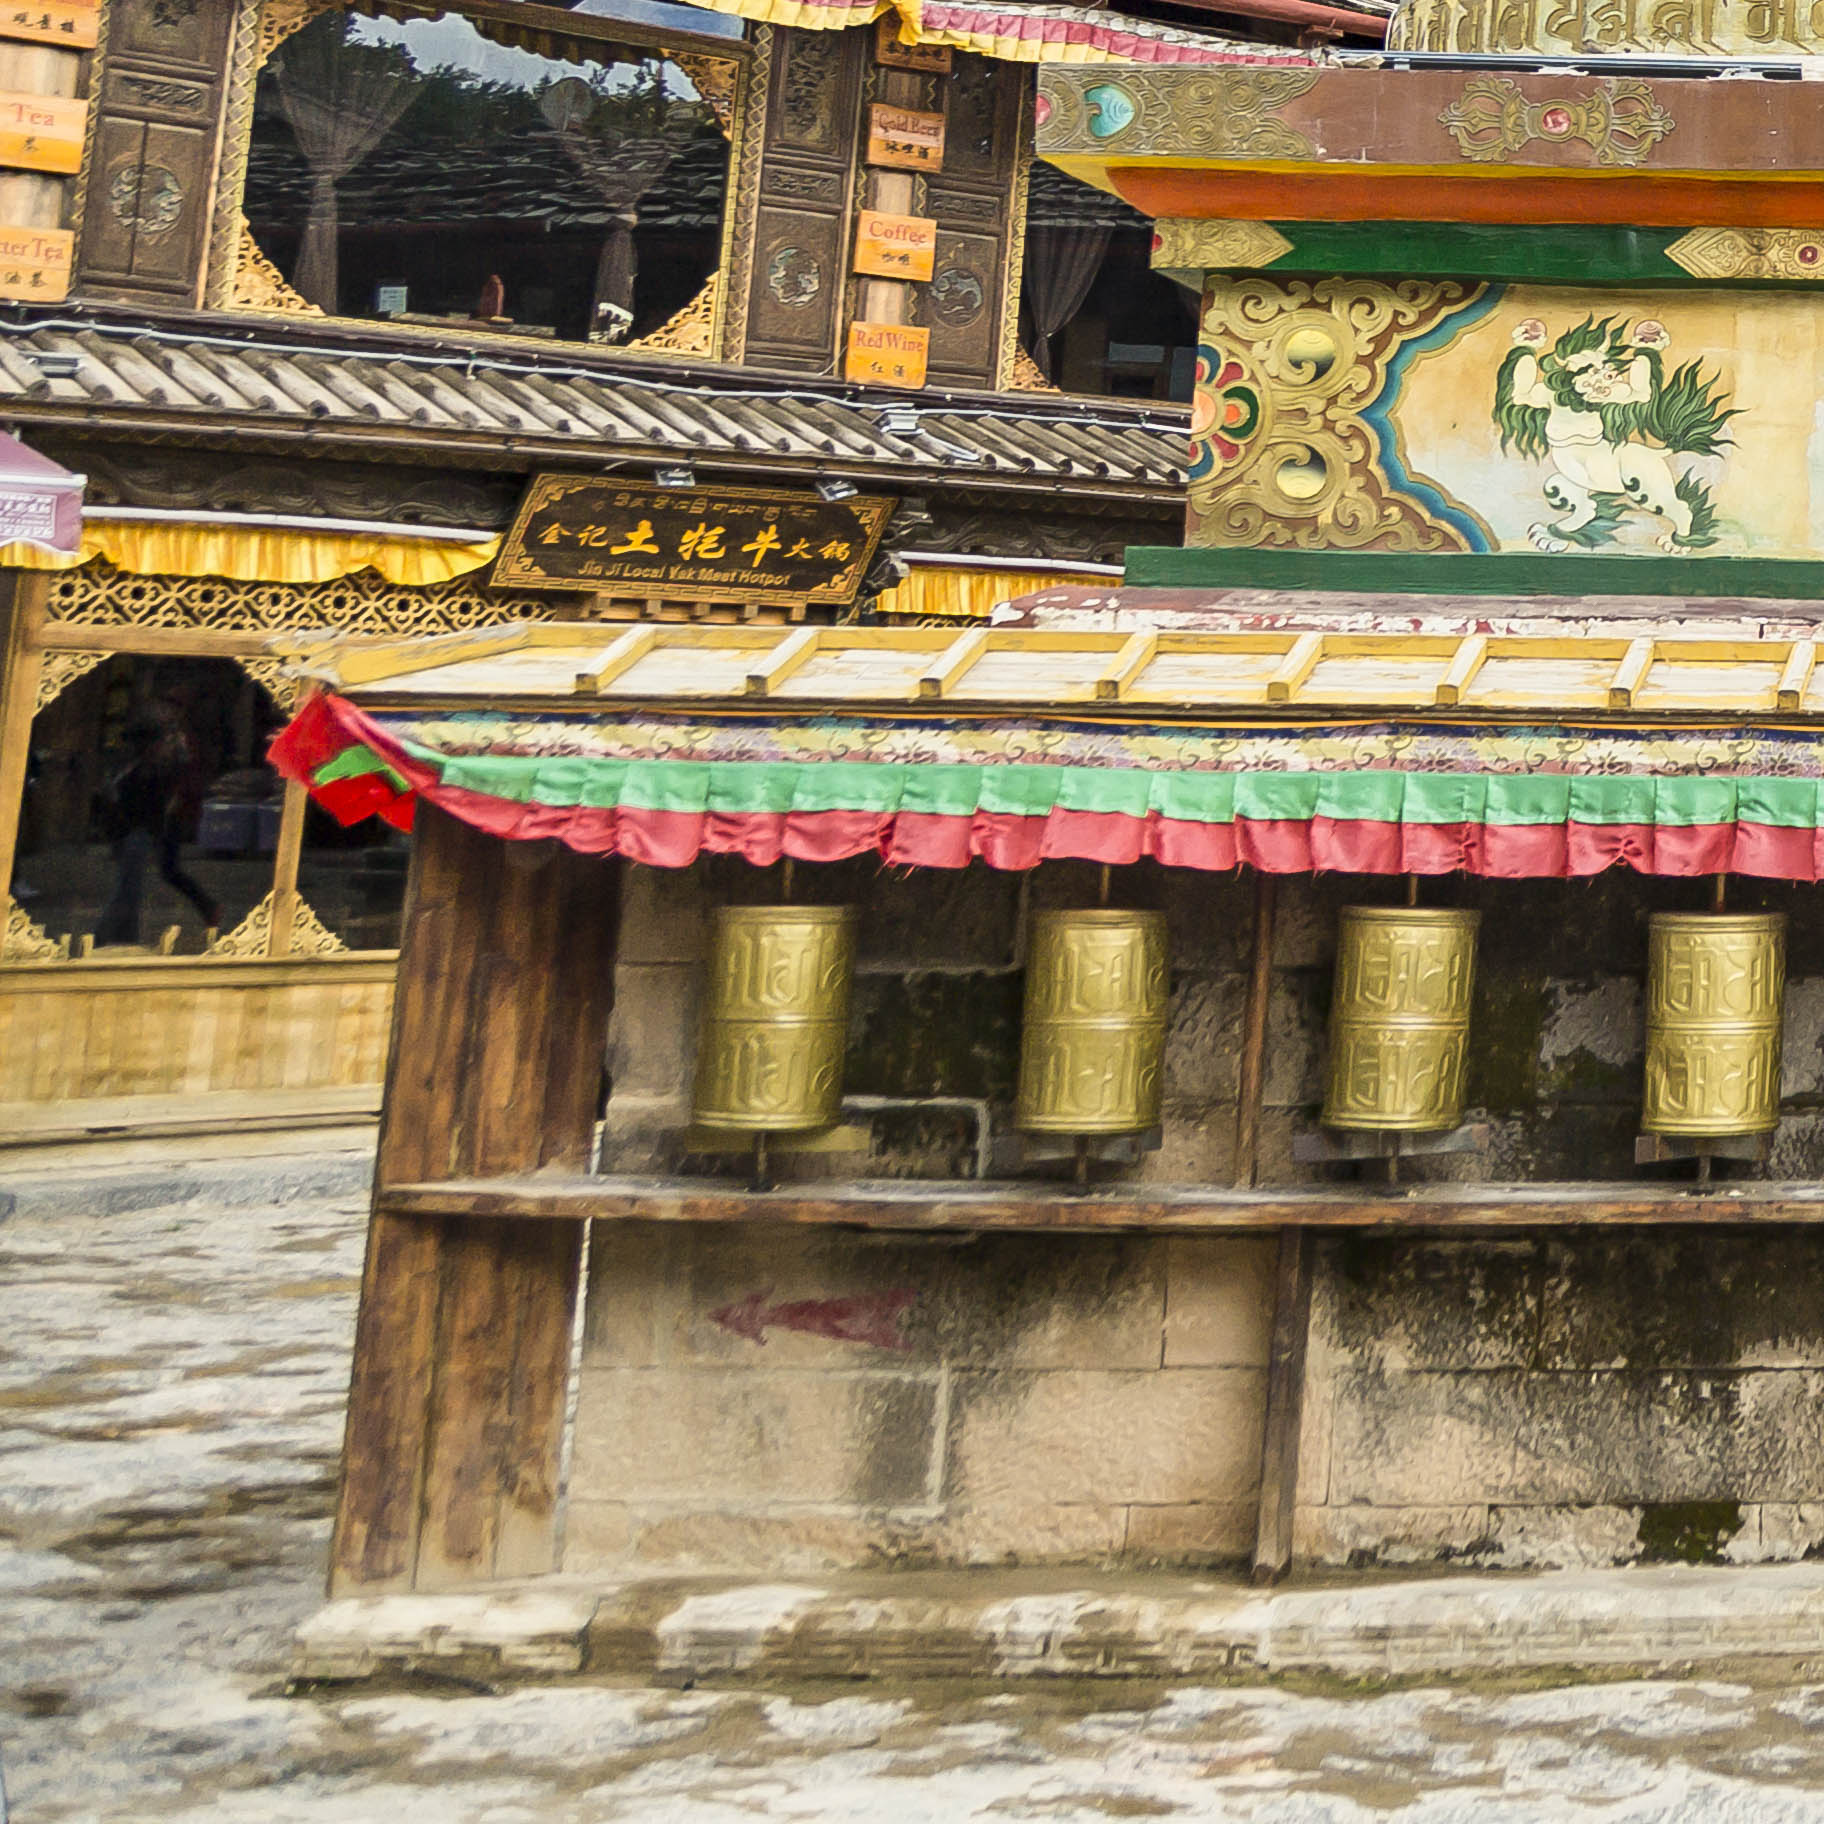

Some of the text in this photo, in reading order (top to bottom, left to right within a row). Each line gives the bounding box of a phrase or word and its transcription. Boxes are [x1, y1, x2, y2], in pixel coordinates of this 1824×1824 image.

[10, 103, 55, 127] Tea
[869, 220, 928, 245] Coffee
[32, 237, 63, 260] Tea
[855, 329, 924, 353] Red Wine
[537, 520, 852, 568] 金记土牦牛火锅
[623, 564, 666, 578] Local
[668, 566, 695, 580] Yak
[697, 567, 736, 582] Meat
[737, 570, 791, 586] Hotpot
